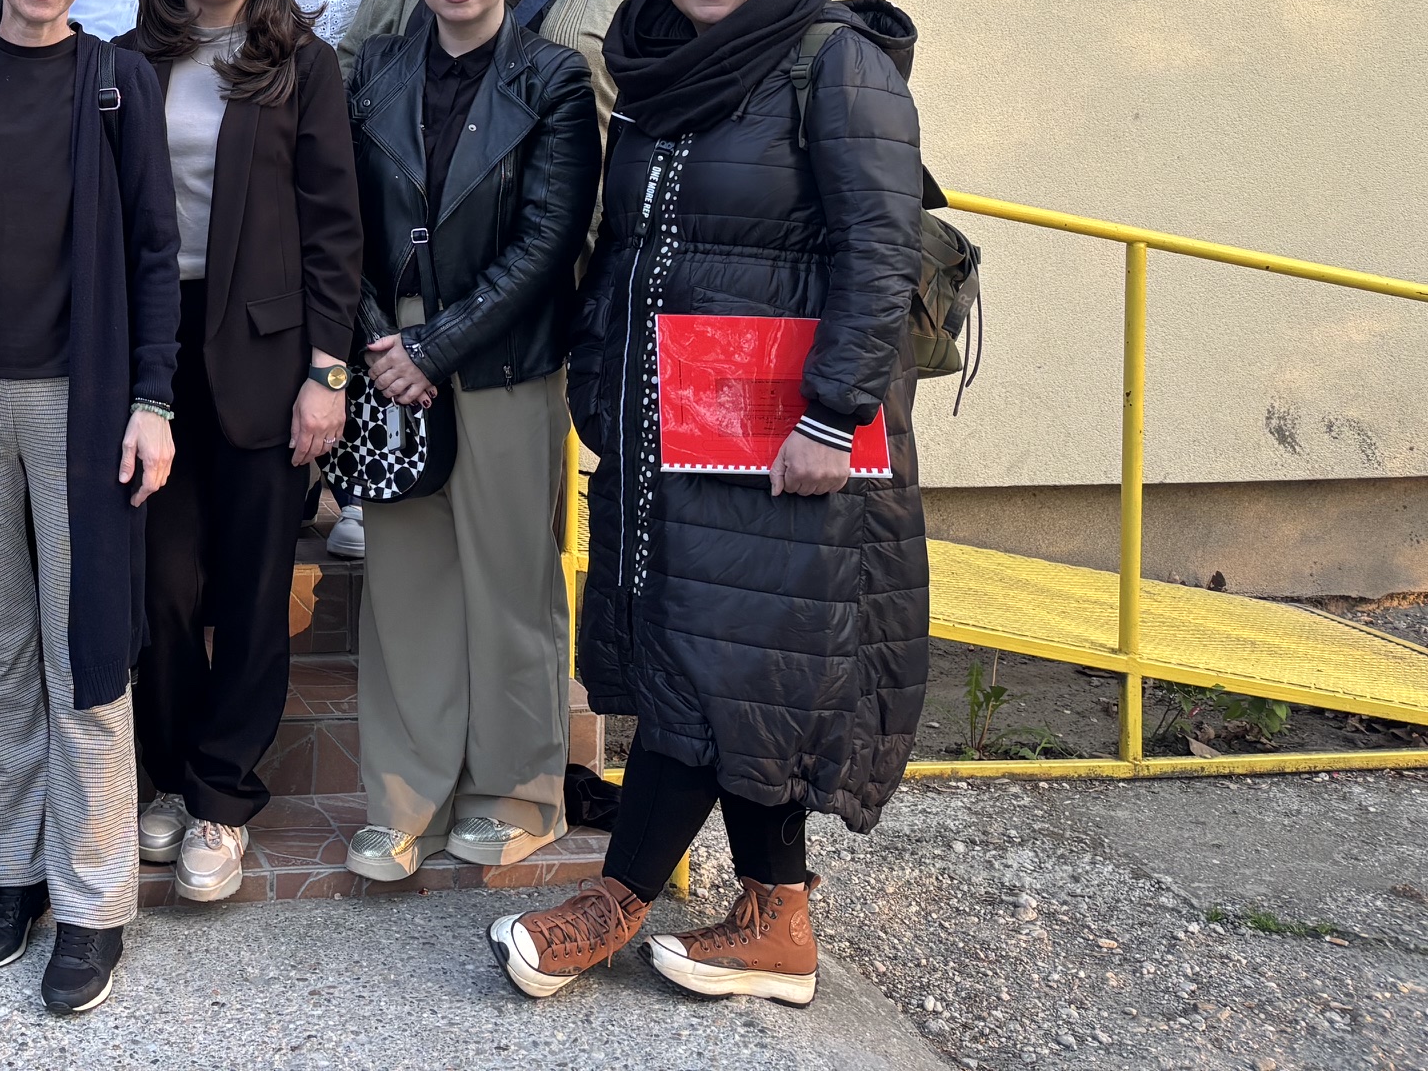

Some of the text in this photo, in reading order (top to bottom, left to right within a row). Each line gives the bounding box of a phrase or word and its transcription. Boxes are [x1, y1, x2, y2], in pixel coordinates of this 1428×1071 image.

[641, 165, 662, 219] ONE MORE REP
